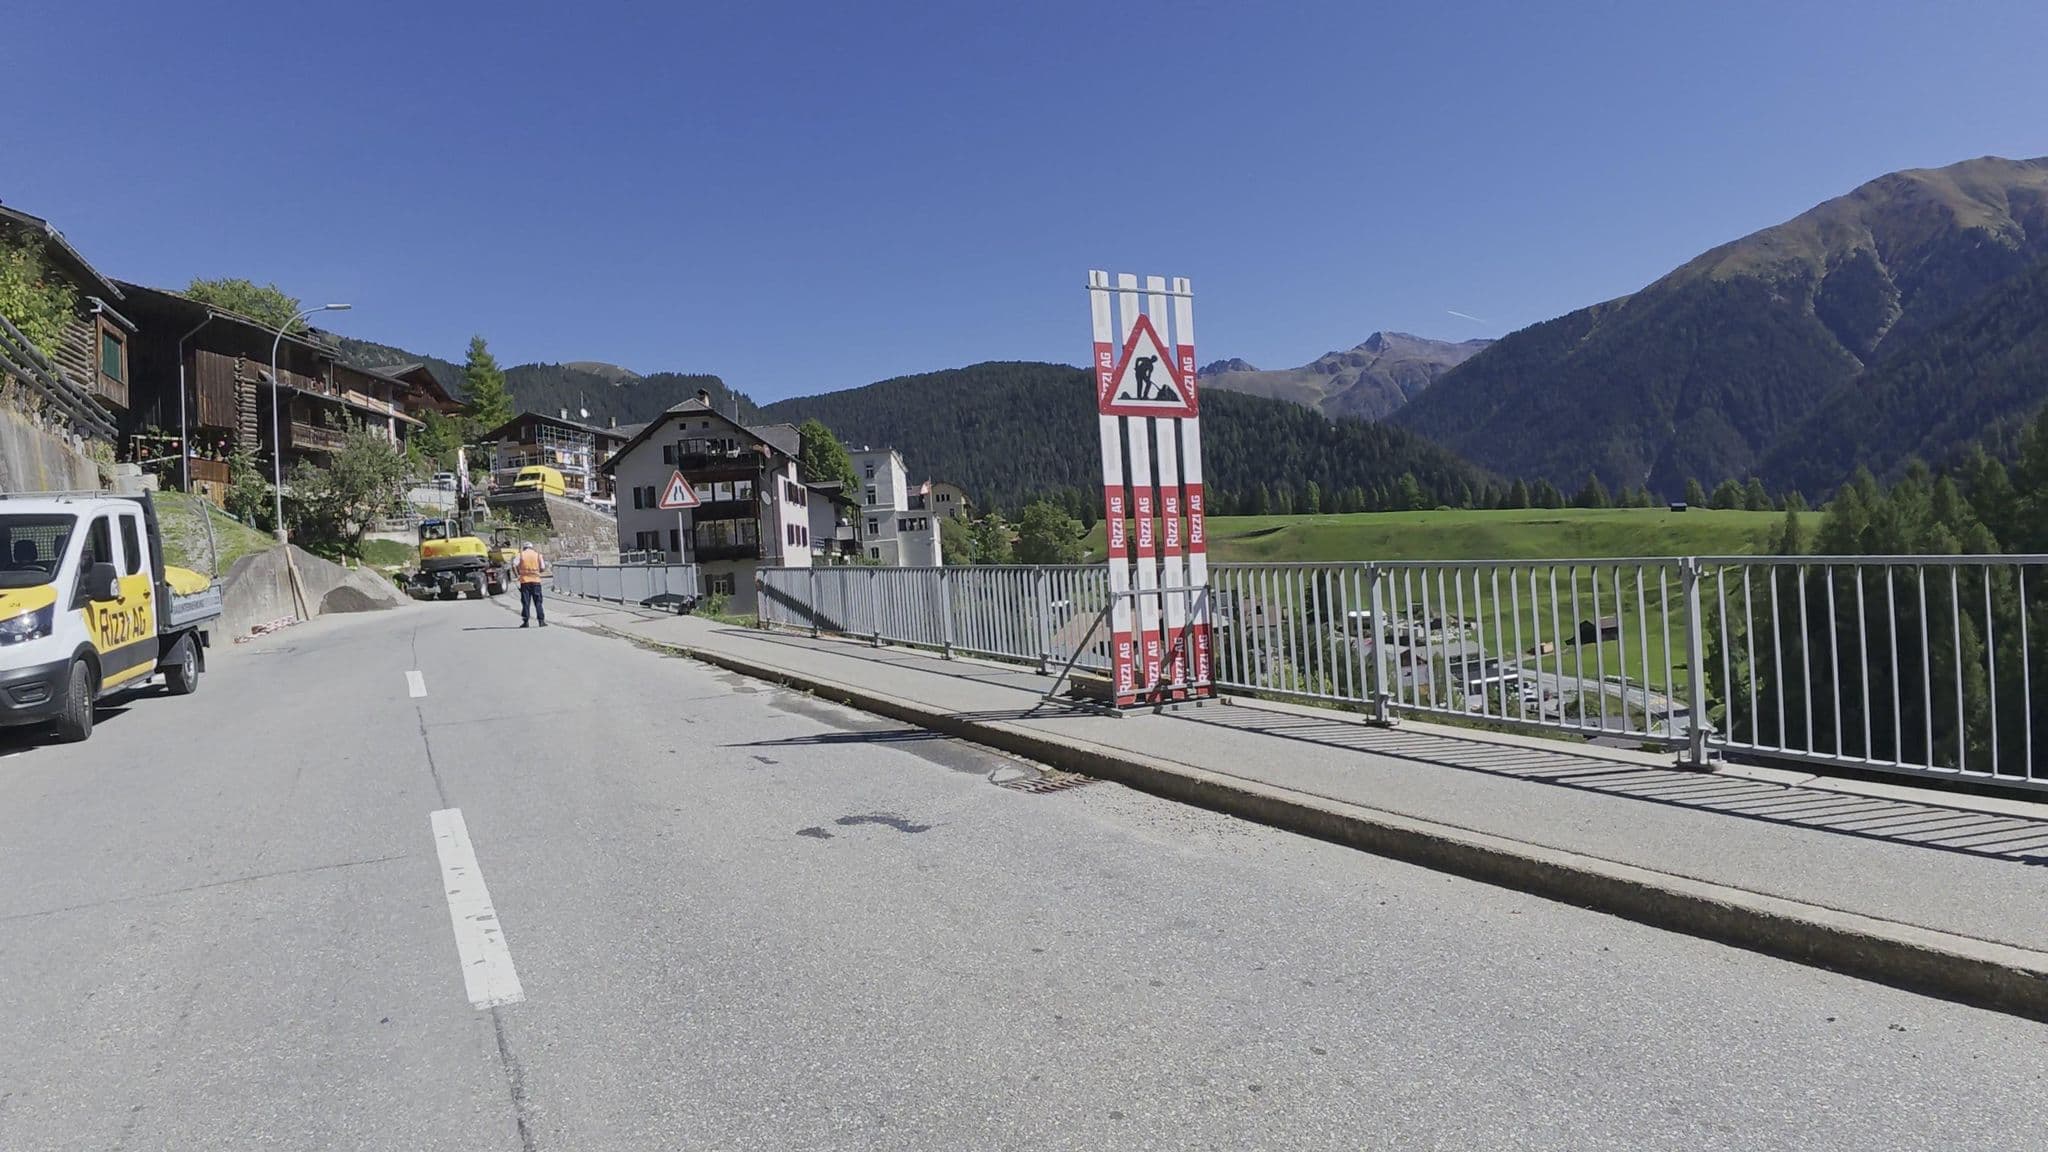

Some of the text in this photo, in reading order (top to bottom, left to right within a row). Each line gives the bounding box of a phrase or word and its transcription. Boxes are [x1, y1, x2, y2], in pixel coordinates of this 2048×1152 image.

[1100, 351, 1112, 369] AG
[1183, 356, 1193, 373] AG
[1111, 496, 1124, 548] RIZZI AG
[1138, 497, 1152, 548] RIZZI AG
[1166, 497, 1178, 547] RIZZI AG
[1190, 494, 1202, 544] RIZZI AG
[100, 605, 146, 649] RIZZI AG
[1147, 640, 1158, 657] AG
[1119, 642, 1132, 693] RIZZI AG
[1174, 636, 1185, 686] RIZZI AG
[1198, 634, 1209, 683] RIZZI AG
